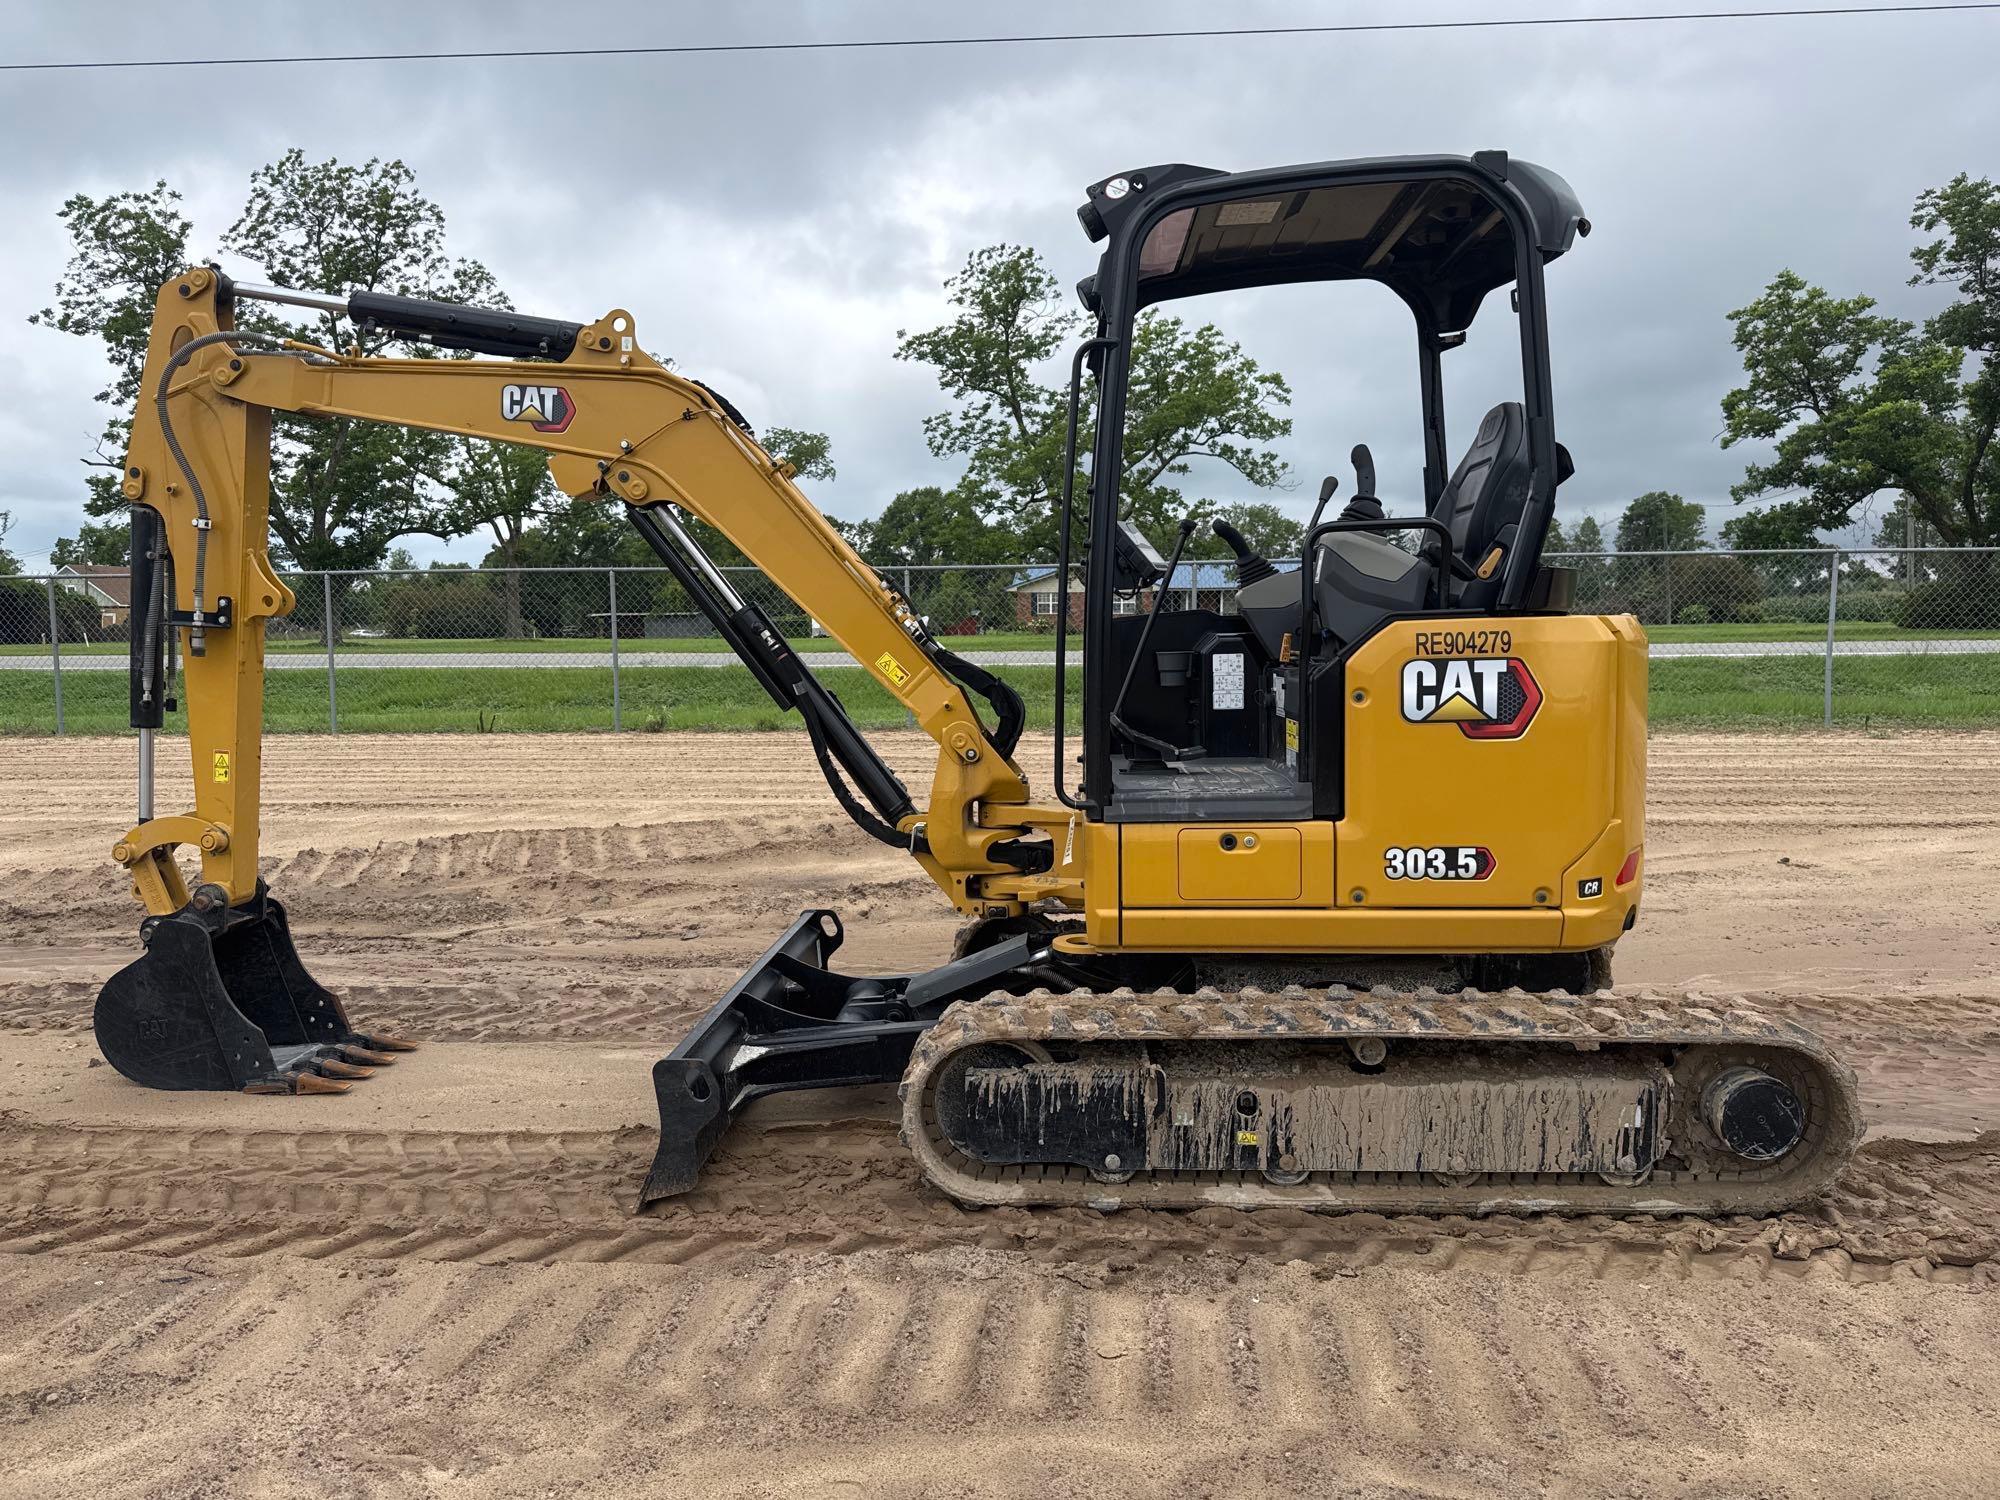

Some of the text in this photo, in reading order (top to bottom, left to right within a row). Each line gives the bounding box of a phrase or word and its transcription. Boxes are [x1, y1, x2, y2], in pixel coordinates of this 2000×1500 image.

[502, 385, 558, 422] CAT
[1416, 631, 1511, 655] RE904279
[1403, 660, 1507, 721] CAT
[1385, 848, 1477, 878] 303.5
[1584, 881, 1599, 894] CR
